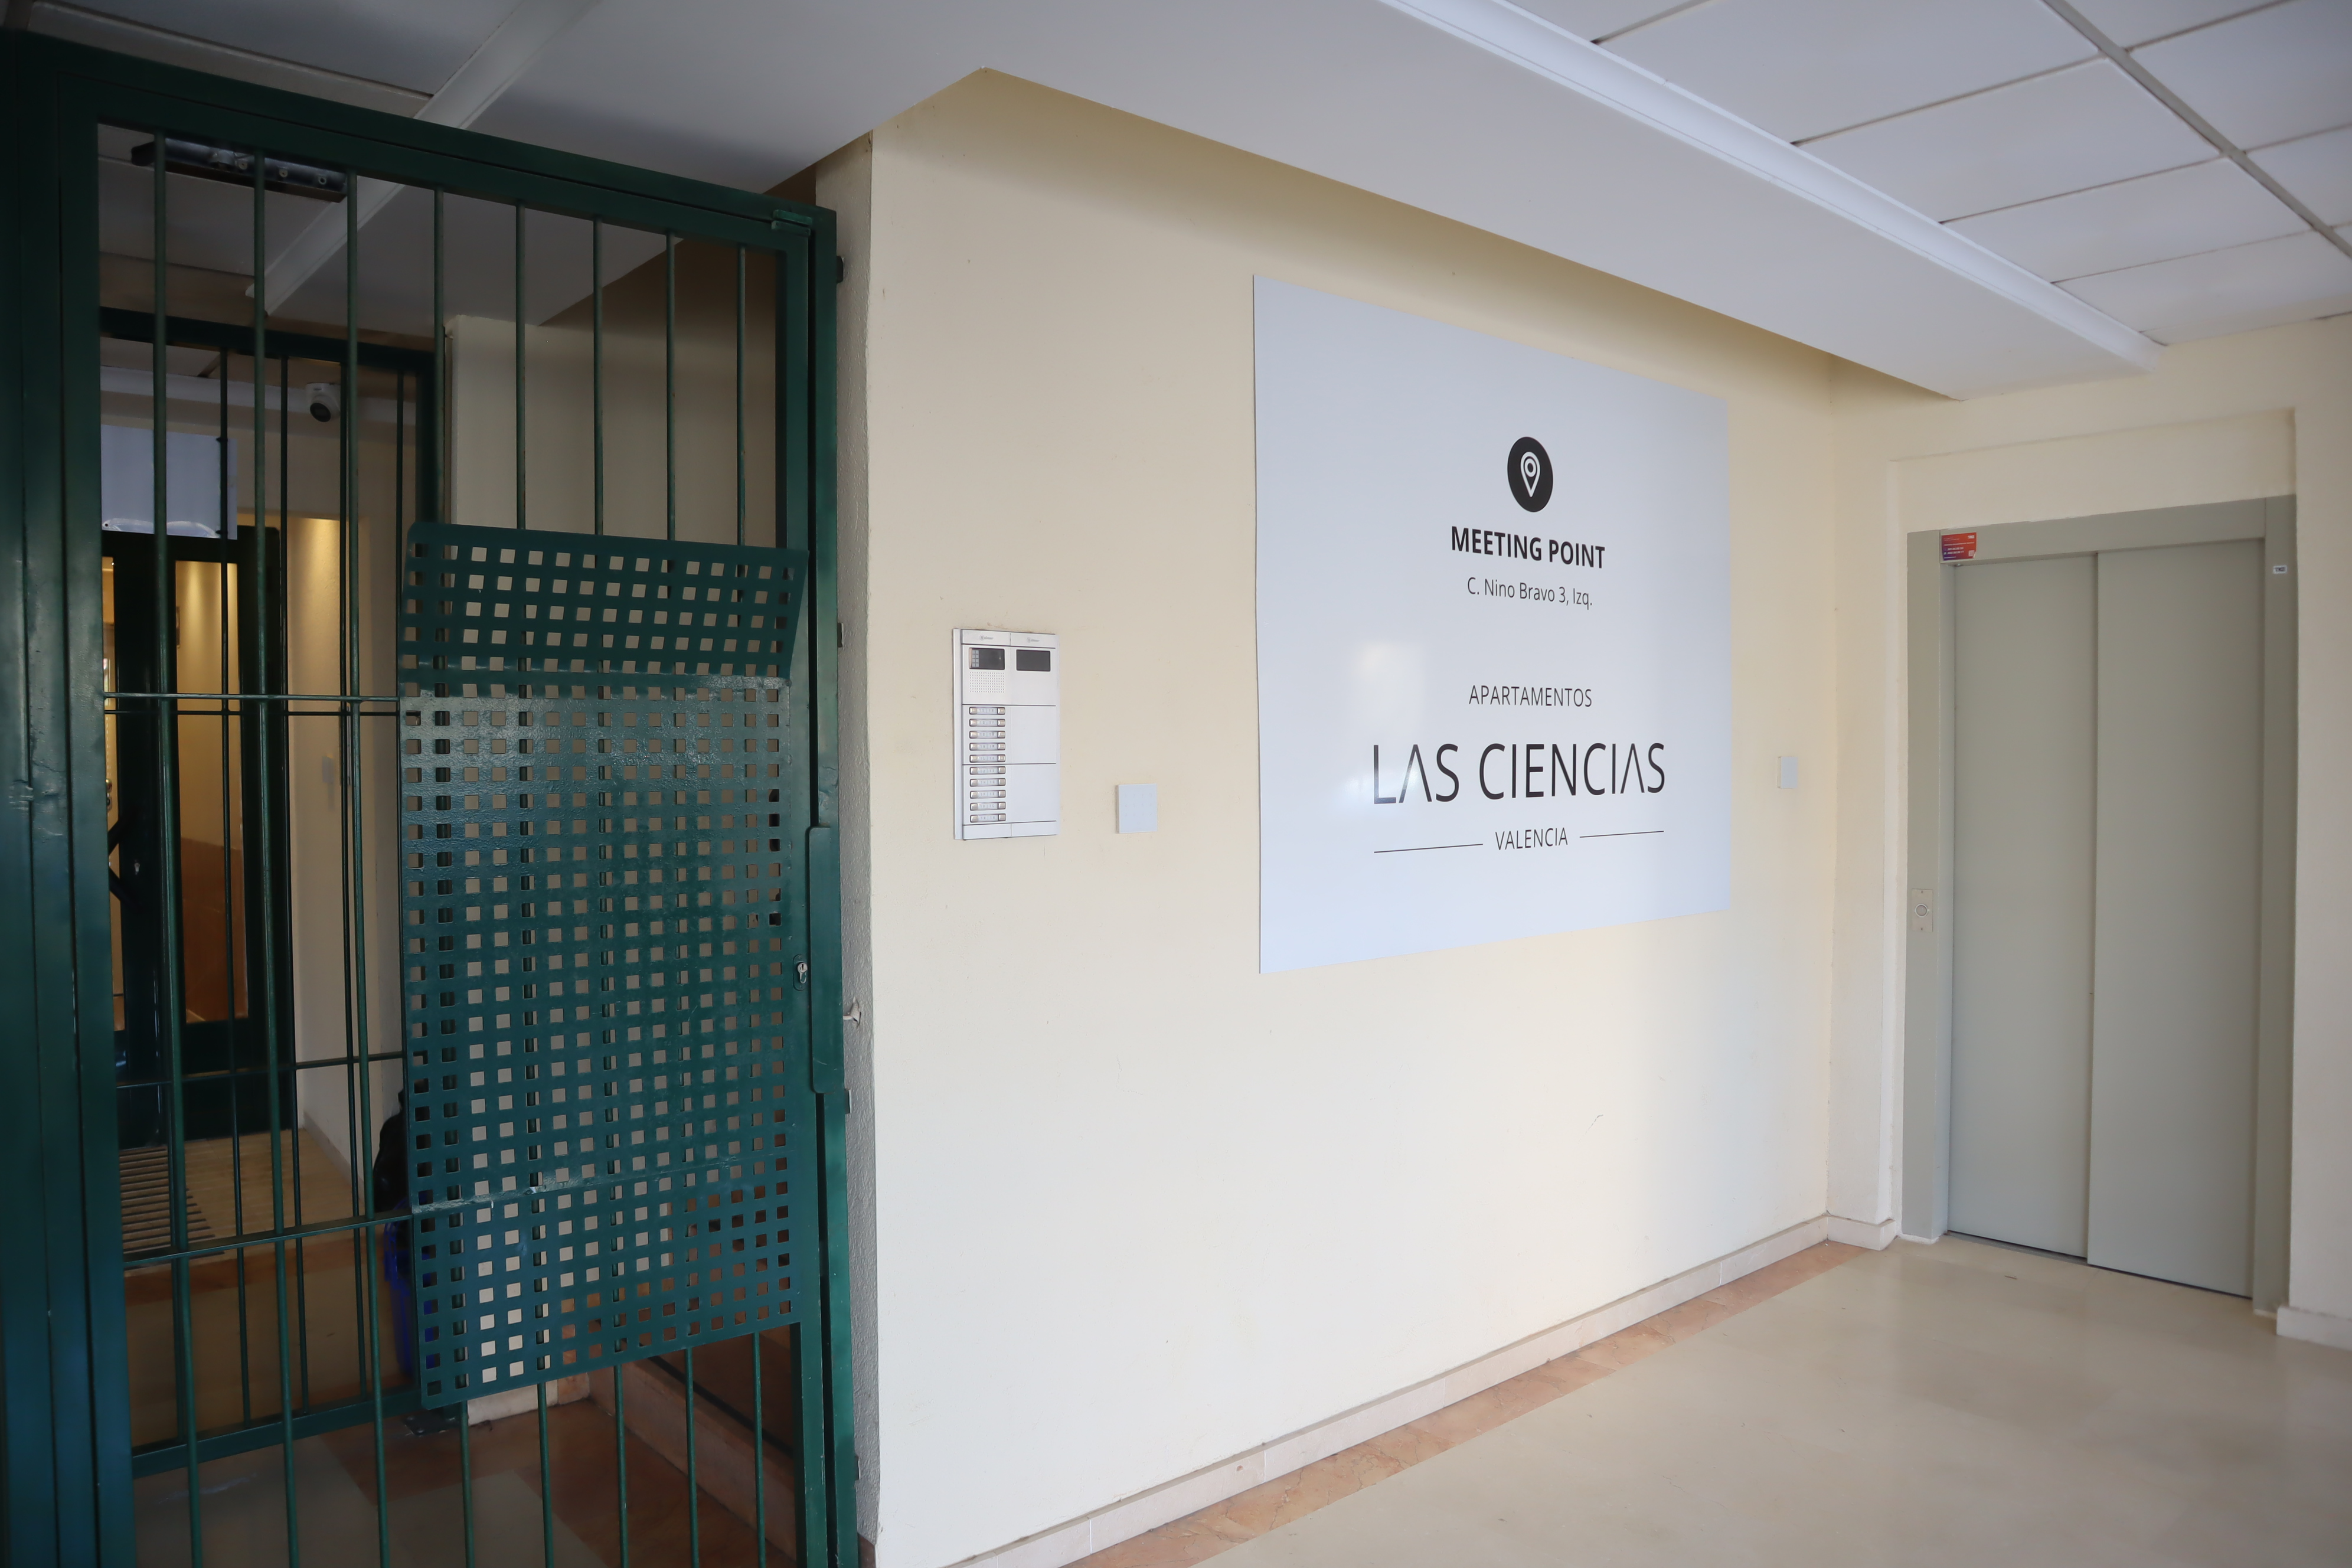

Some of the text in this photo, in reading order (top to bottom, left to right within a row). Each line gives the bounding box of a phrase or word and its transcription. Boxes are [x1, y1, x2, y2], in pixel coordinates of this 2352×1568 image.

[1452, 526, 1605, 569] MEETING POINT
[1467, 577, 1593, 610] C. Nino Bravo 3, Izq.
[1468, 685, 1592, 707] APARTAMENTOS
[1373, 742, 1665, 805] LAS CIENCIAS
[1495, 827, 1568, 851] VALENCIA
